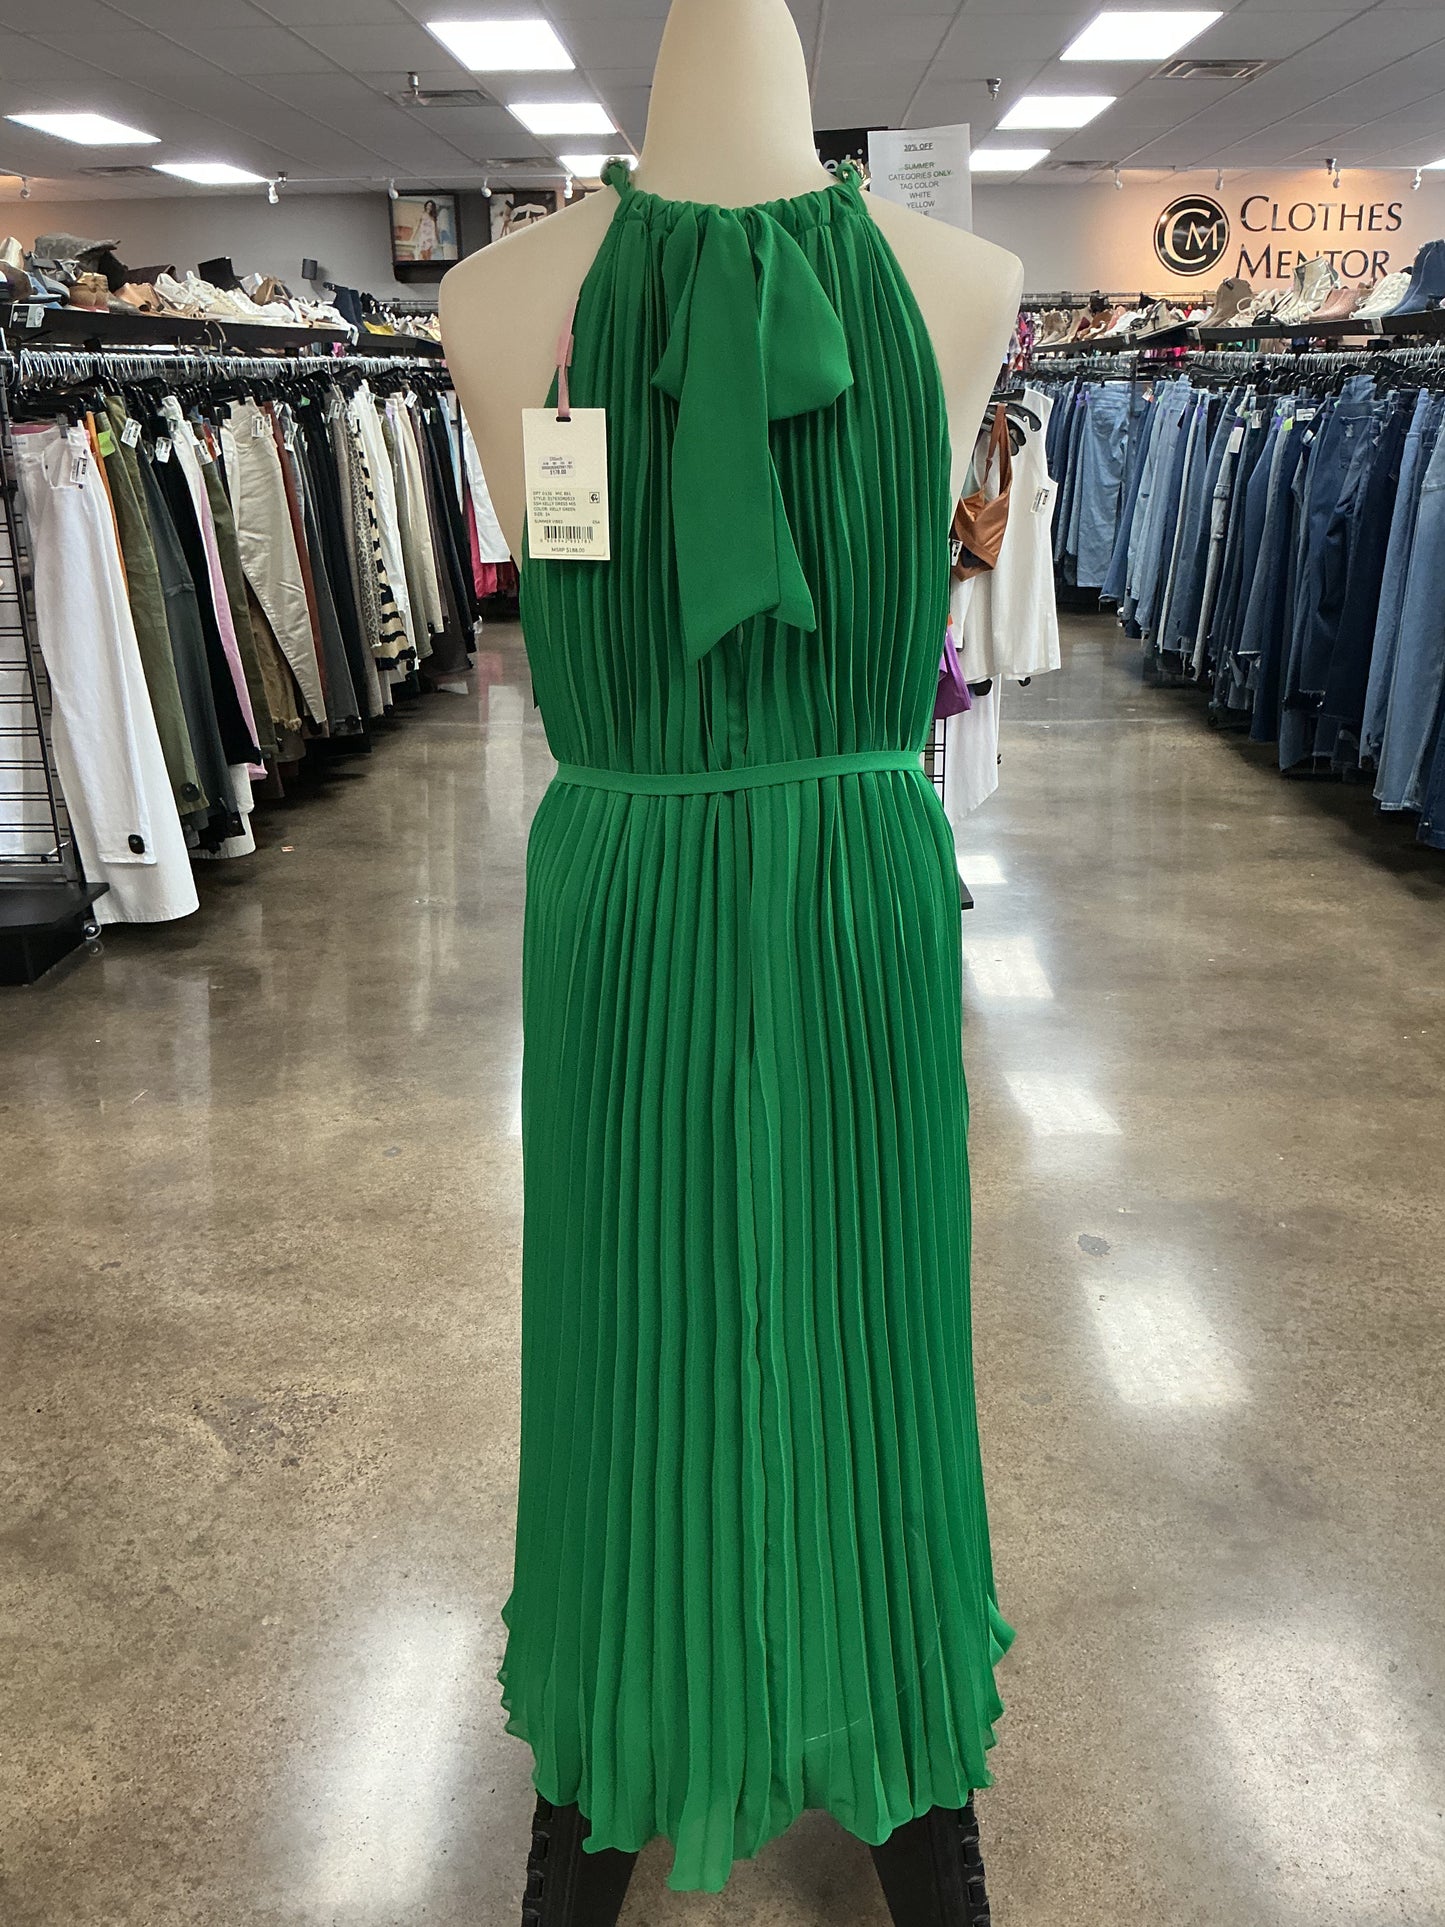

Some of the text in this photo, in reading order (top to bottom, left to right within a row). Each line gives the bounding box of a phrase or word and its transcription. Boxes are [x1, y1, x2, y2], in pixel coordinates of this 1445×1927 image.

[919, 142, 934, 151] OFF
[904, 162, 935, 170] SUMMER
[888, 169, 953, 181] CATEGORIES ONLY
[914, 180, 940, 189] COLOR
[909, 191, 931, 199] WHITE
[906, 200, 936, 209] YELLOW
[1240, 195, 1403, 232] CLOTHES
